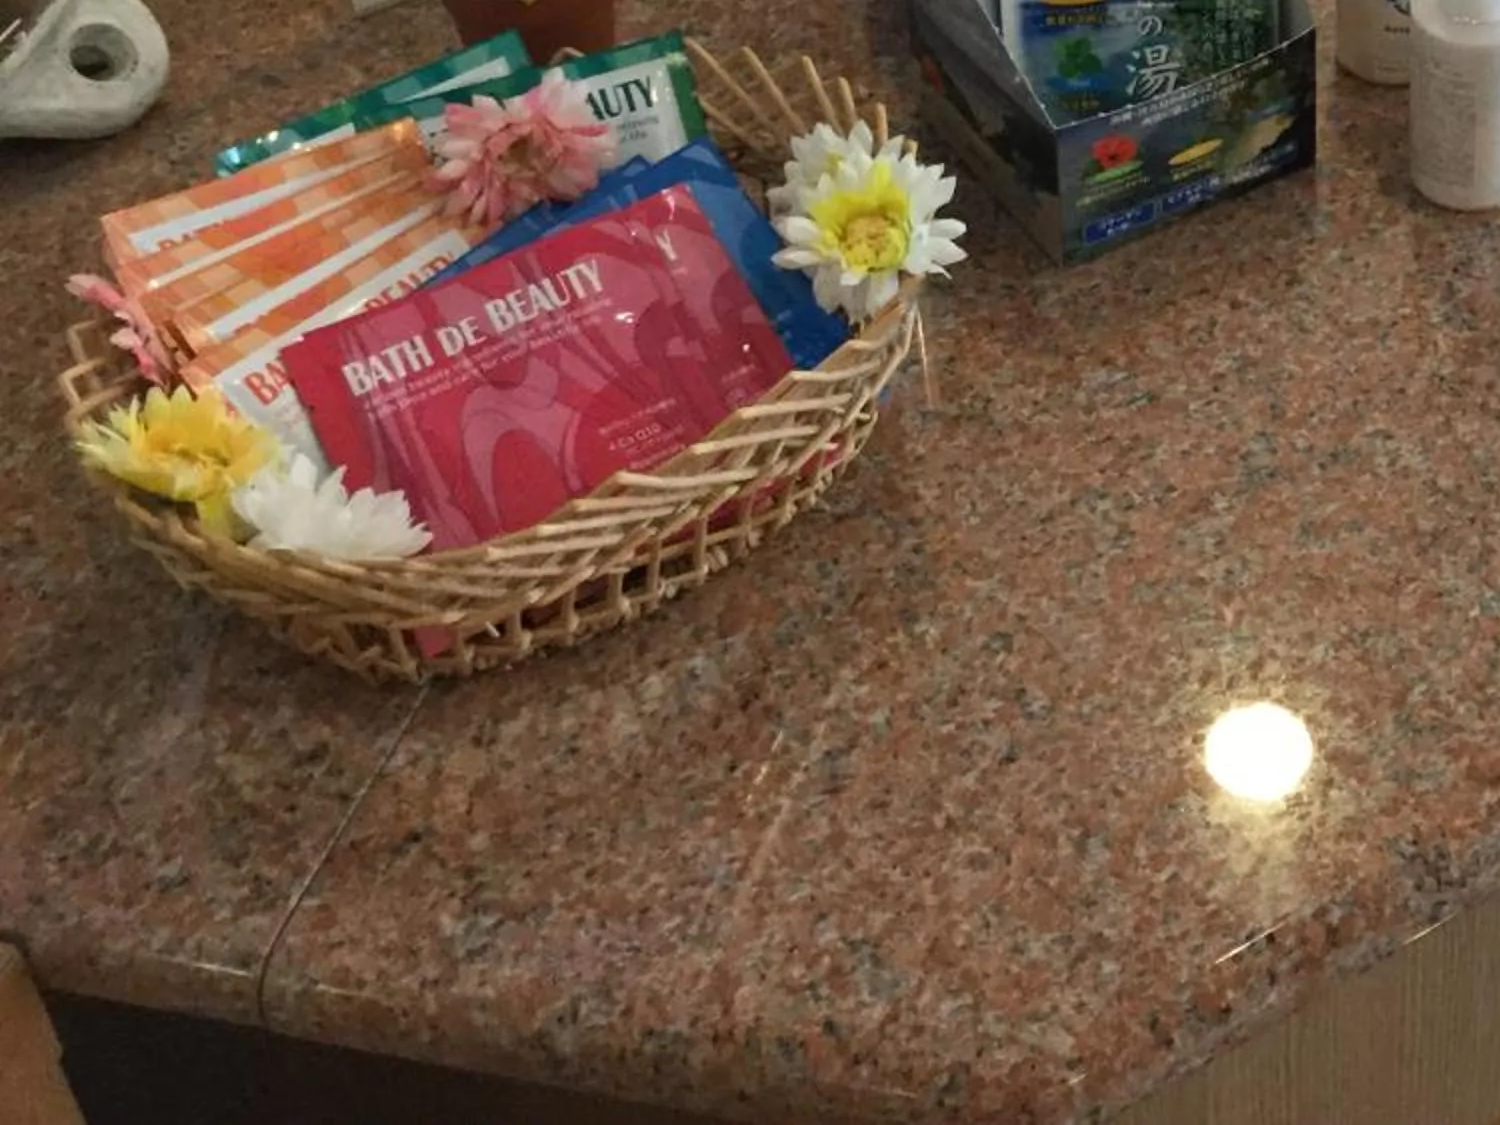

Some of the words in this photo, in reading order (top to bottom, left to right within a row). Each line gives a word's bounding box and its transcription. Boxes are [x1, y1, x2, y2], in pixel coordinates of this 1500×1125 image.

[342, 334, 435, 397] BATH
[435, 315, 487, 358] DE
[484, 258, 605, 334] BEAUTY
